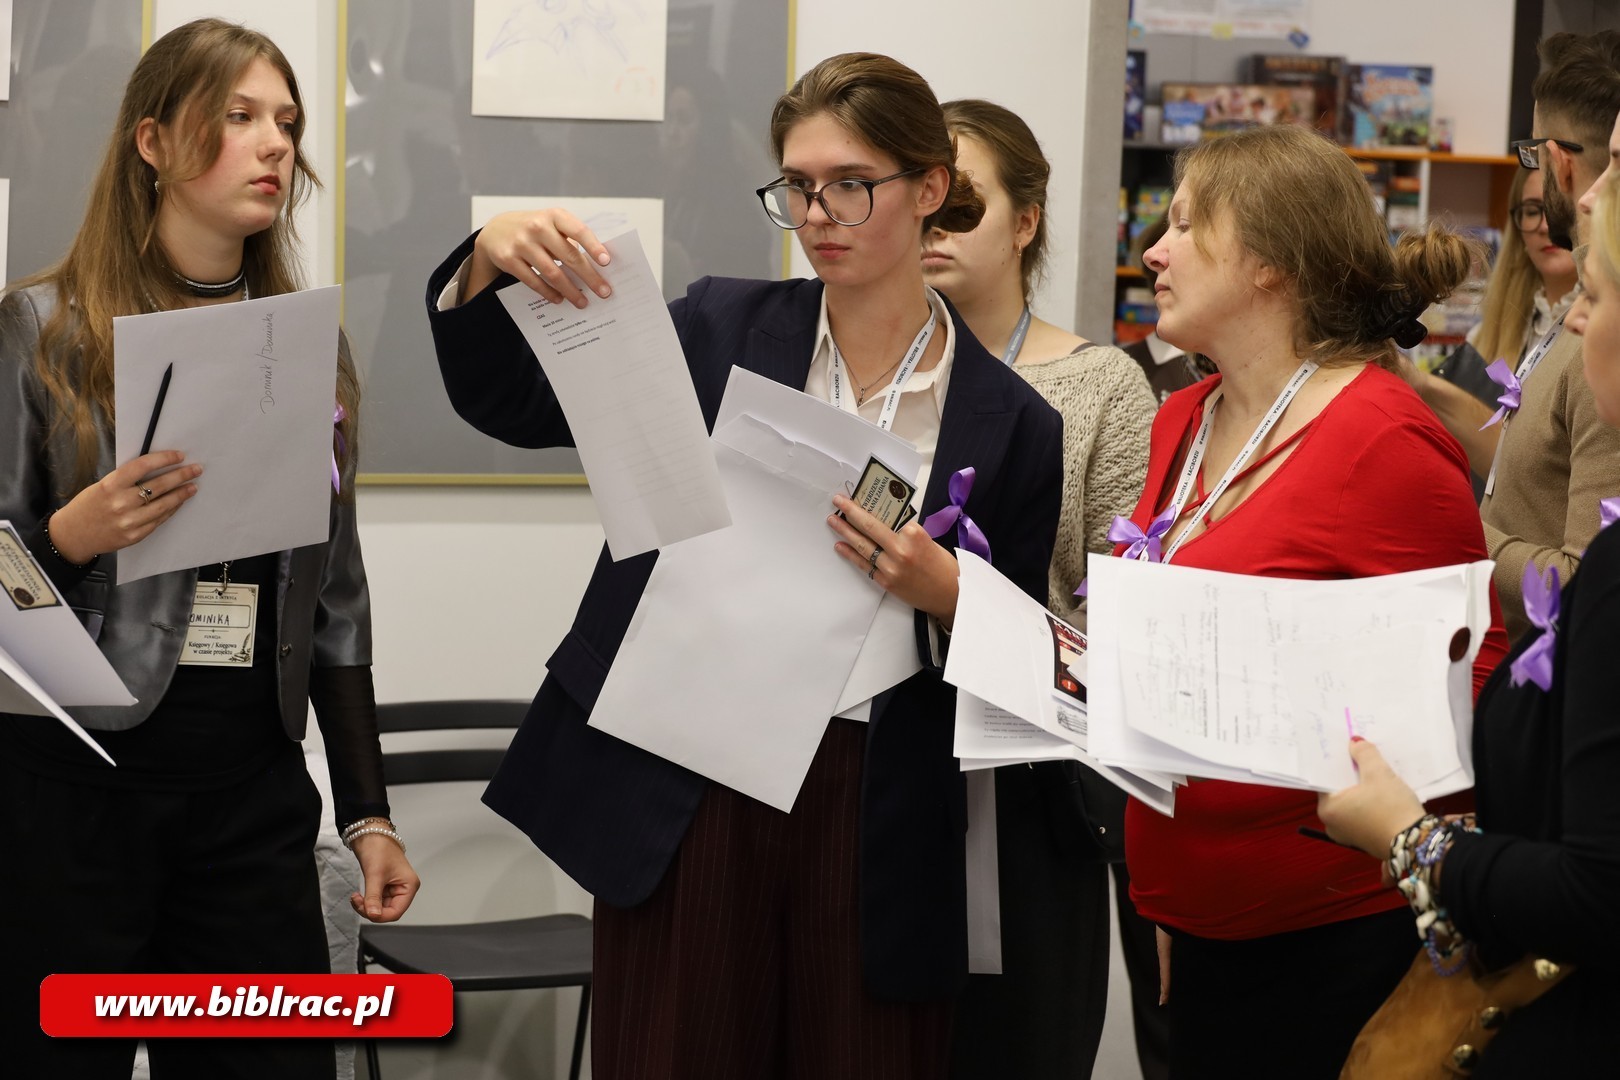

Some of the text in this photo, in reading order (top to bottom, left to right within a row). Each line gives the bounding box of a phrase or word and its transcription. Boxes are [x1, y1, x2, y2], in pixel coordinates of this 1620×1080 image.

[1273, 390, 1292, 414] BIBLIOTEKA
[877, 476, 889, 498] ZADANIA
[1176, 481, 1188, 504] BIBLIOTEKA
[1187, 451, 1200, 476] RACIBORZU
[862, 476, 881, 510] TWIERDZENIE
[190, 613, 230, 626] OMINIKA
